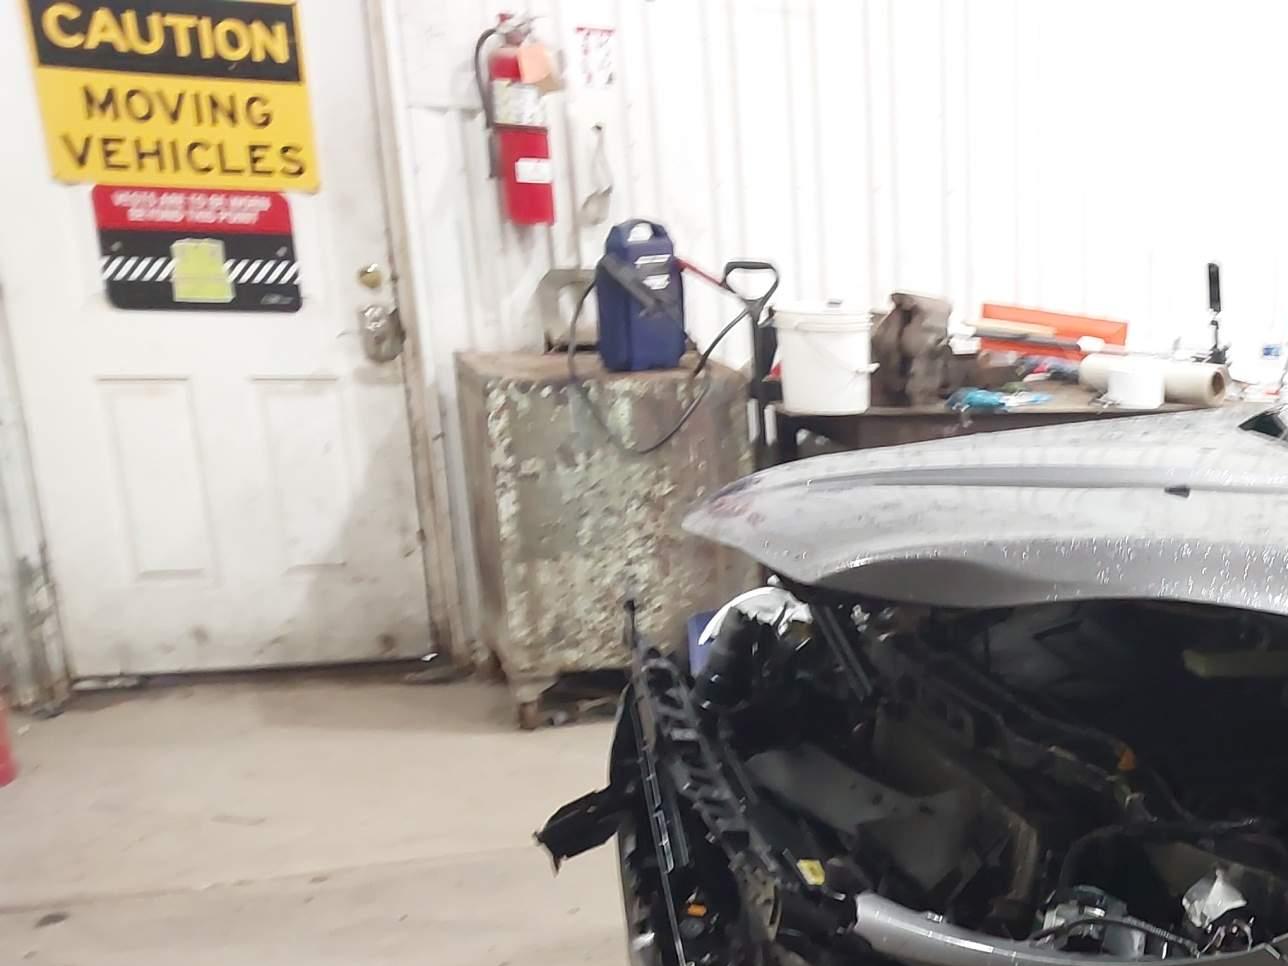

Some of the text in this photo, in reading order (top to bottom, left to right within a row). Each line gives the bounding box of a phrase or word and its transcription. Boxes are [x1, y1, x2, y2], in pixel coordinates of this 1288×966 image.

[40, 5, 291, 65] CAUTION
[80, 82, 275, 130] MOVING
[60, 132, 306, 178] VEHICLES
